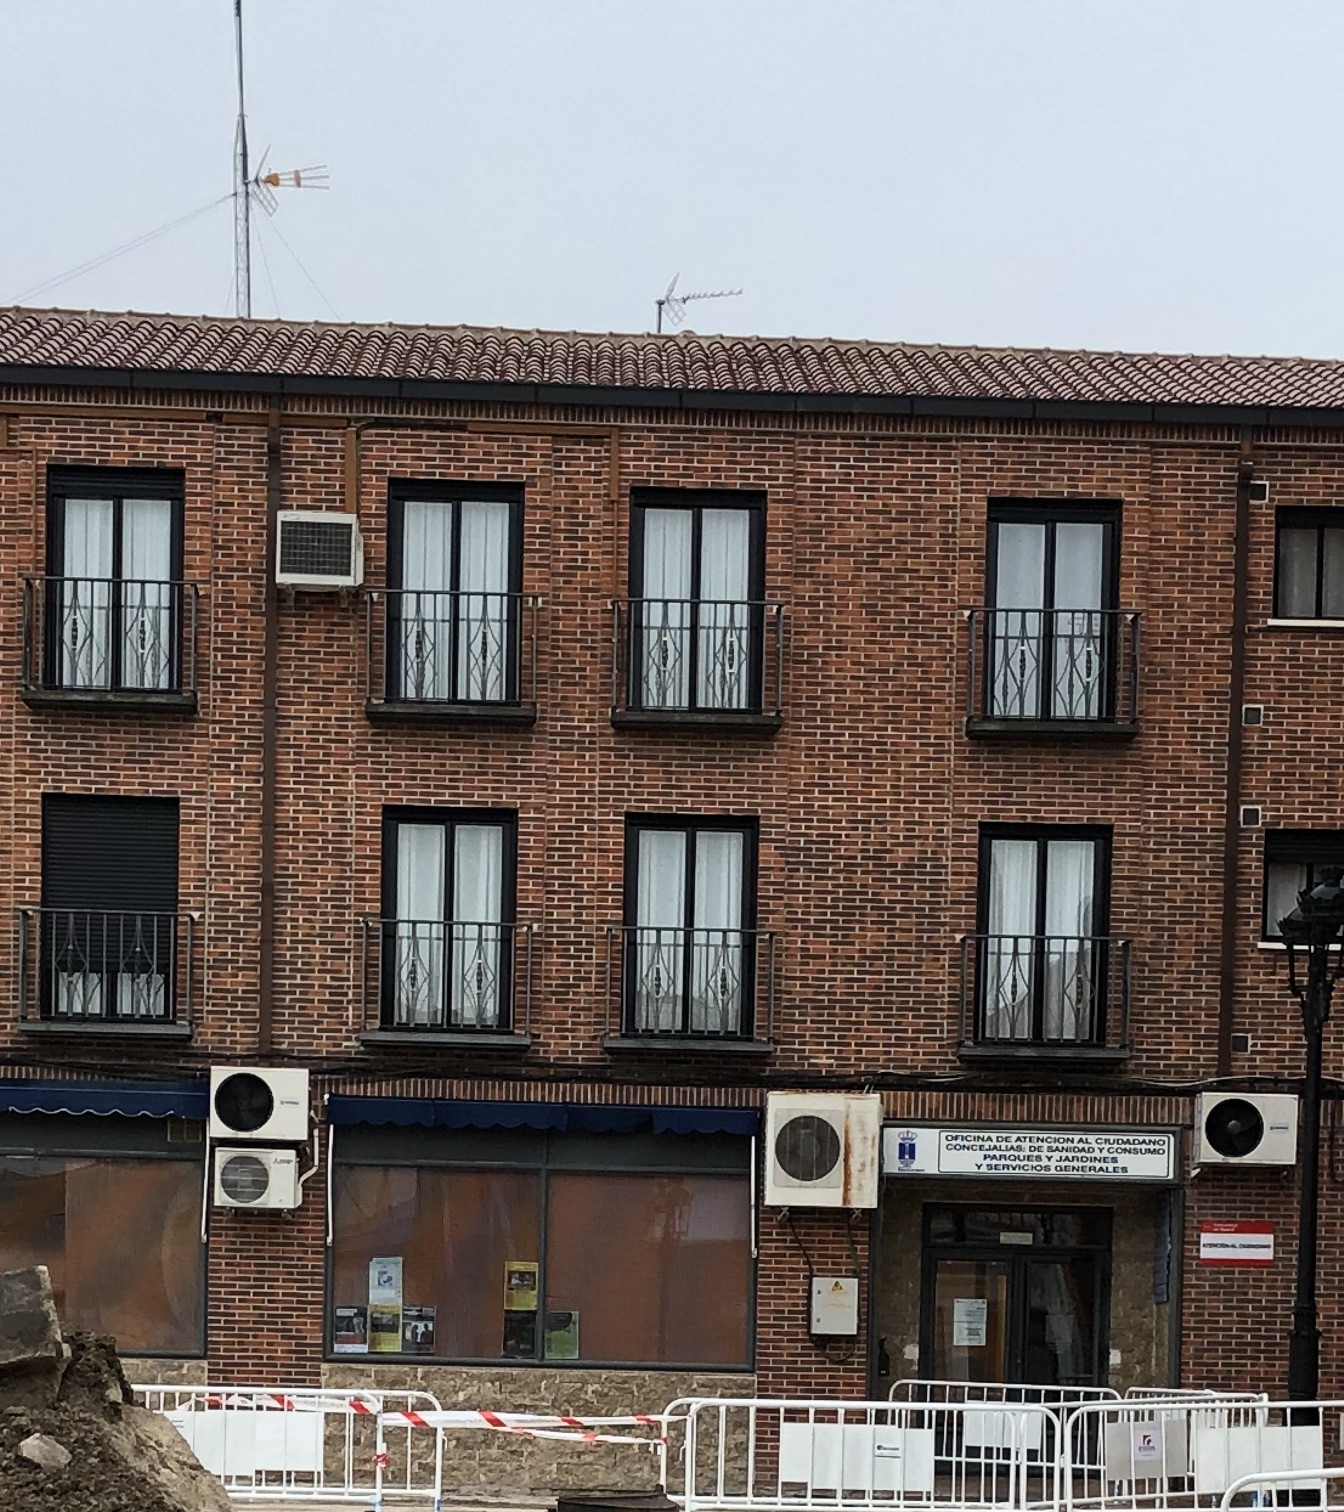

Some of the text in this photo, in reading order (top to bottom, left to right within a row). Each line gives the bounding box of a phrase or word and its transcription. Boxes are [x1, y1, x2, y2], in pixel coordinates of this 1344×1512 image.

[945, 1134, 1166, 1146] OFICINA DE ATENCION AL CIUDADANO
[1029, 1145, 1044, 1153] DE
[1047, 1145, 1095, 1154] SANIDAD
[1107, 1147, 1166, 1155] CONSUMO
[983, 1154, 1043, 1162] PARQUES
[1056, 1156, 1118, 1164] JARDINES
[986, 1163, 1051, 1172] SERVICIOS
[1055, 1165, 1128, 1173] GENERALES
